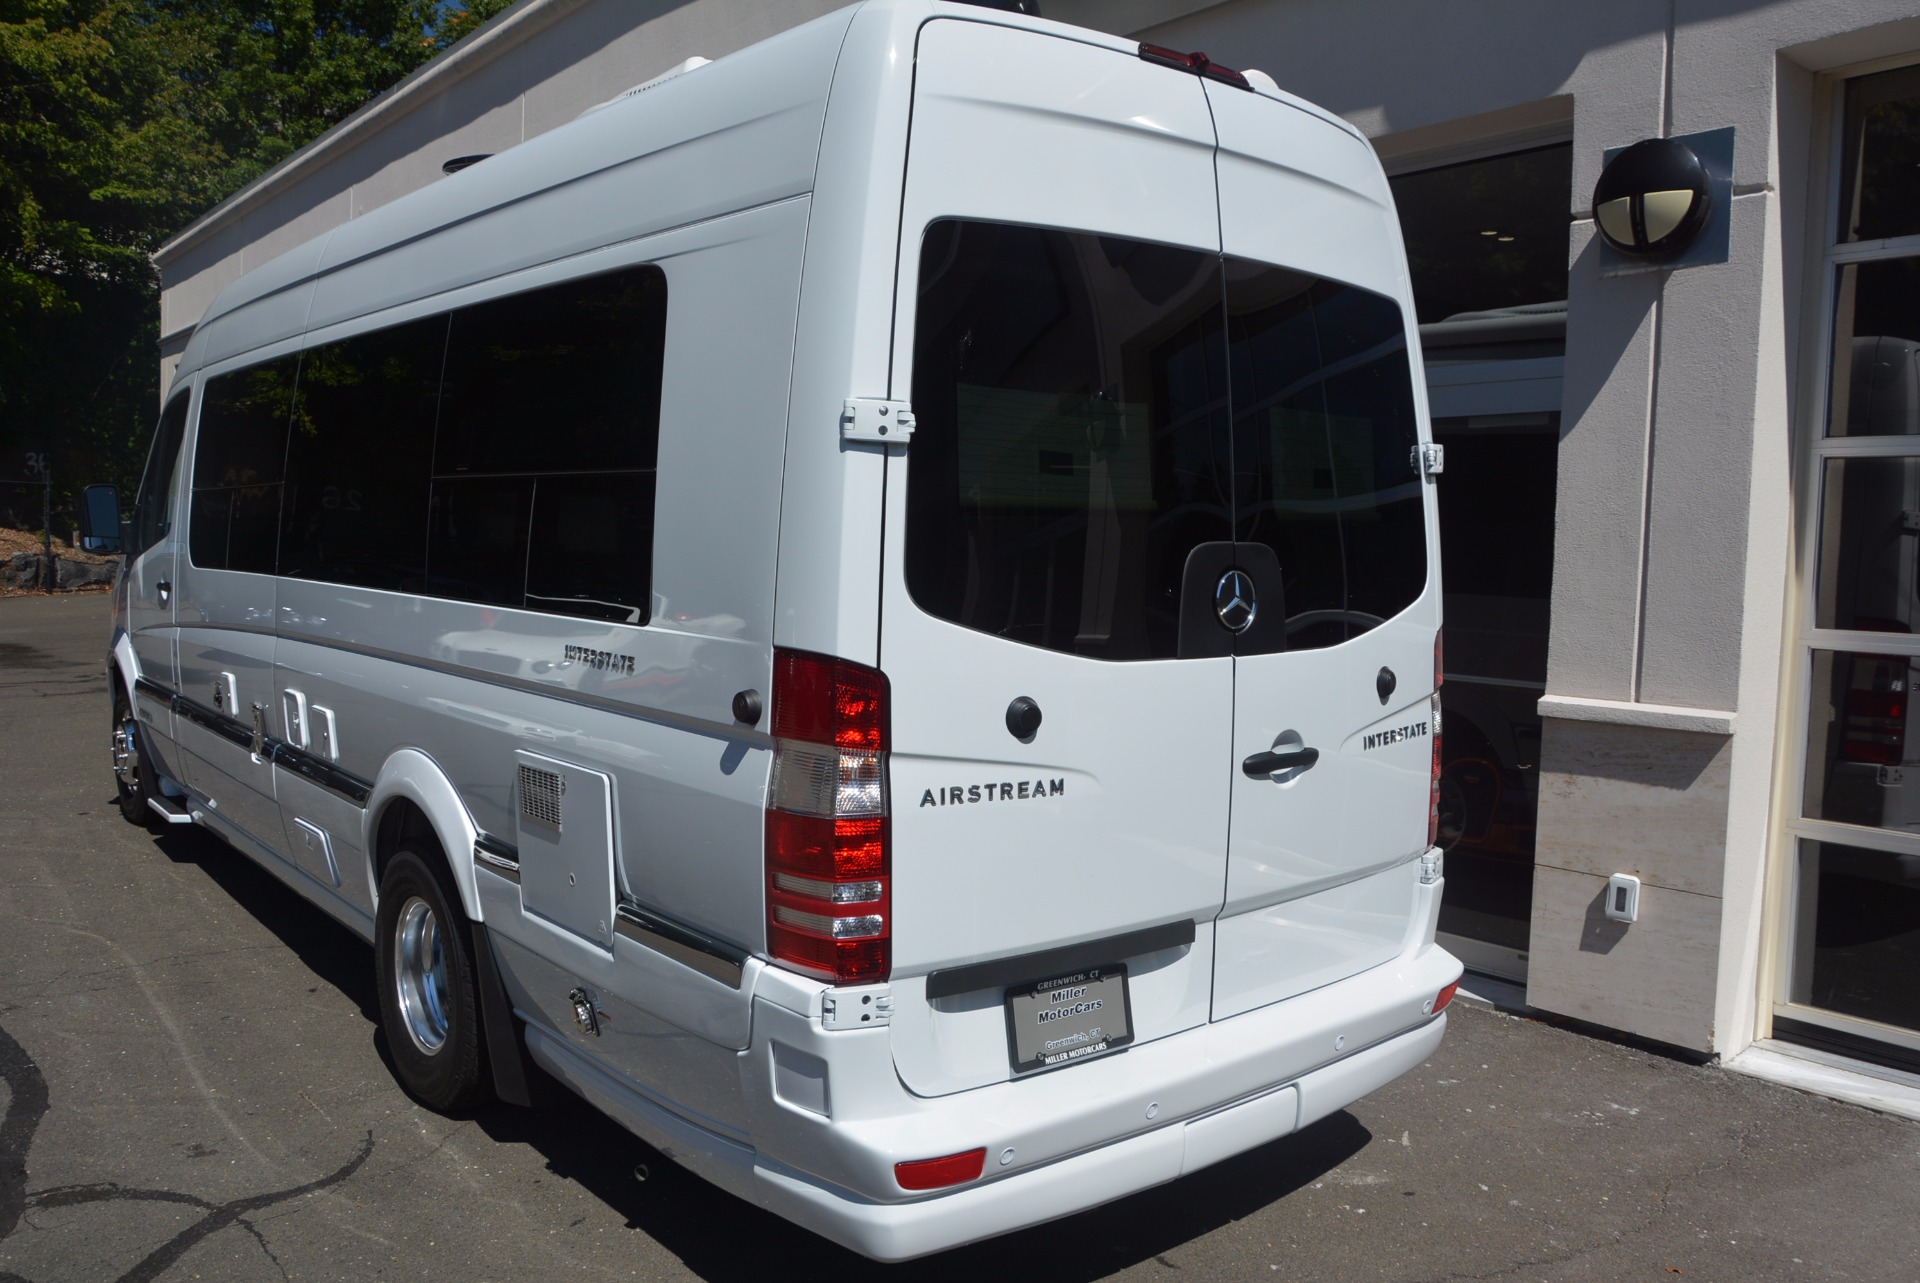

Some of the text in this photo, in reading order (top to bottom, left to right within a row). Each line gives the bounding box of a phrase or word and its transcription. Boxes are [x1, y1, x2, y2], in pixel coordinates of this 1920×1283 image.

[565, 644, 635, 675] INTERSTATE
[1363, 722, 1427, 751] INTERSTATE
[919, 778, 1065, 807] AIRSTREAM
[1037, 970, 1100, 990] GREENWICH, CT
[1051, 987, 1086, 1004] Miller
[1038, 1000, 1102, 1024] MotorCars
[1045, 1028, 1101, 1050] Greenwich, CT
[1045, 1042, 1107, 1065] MILLER MOTORCARS
